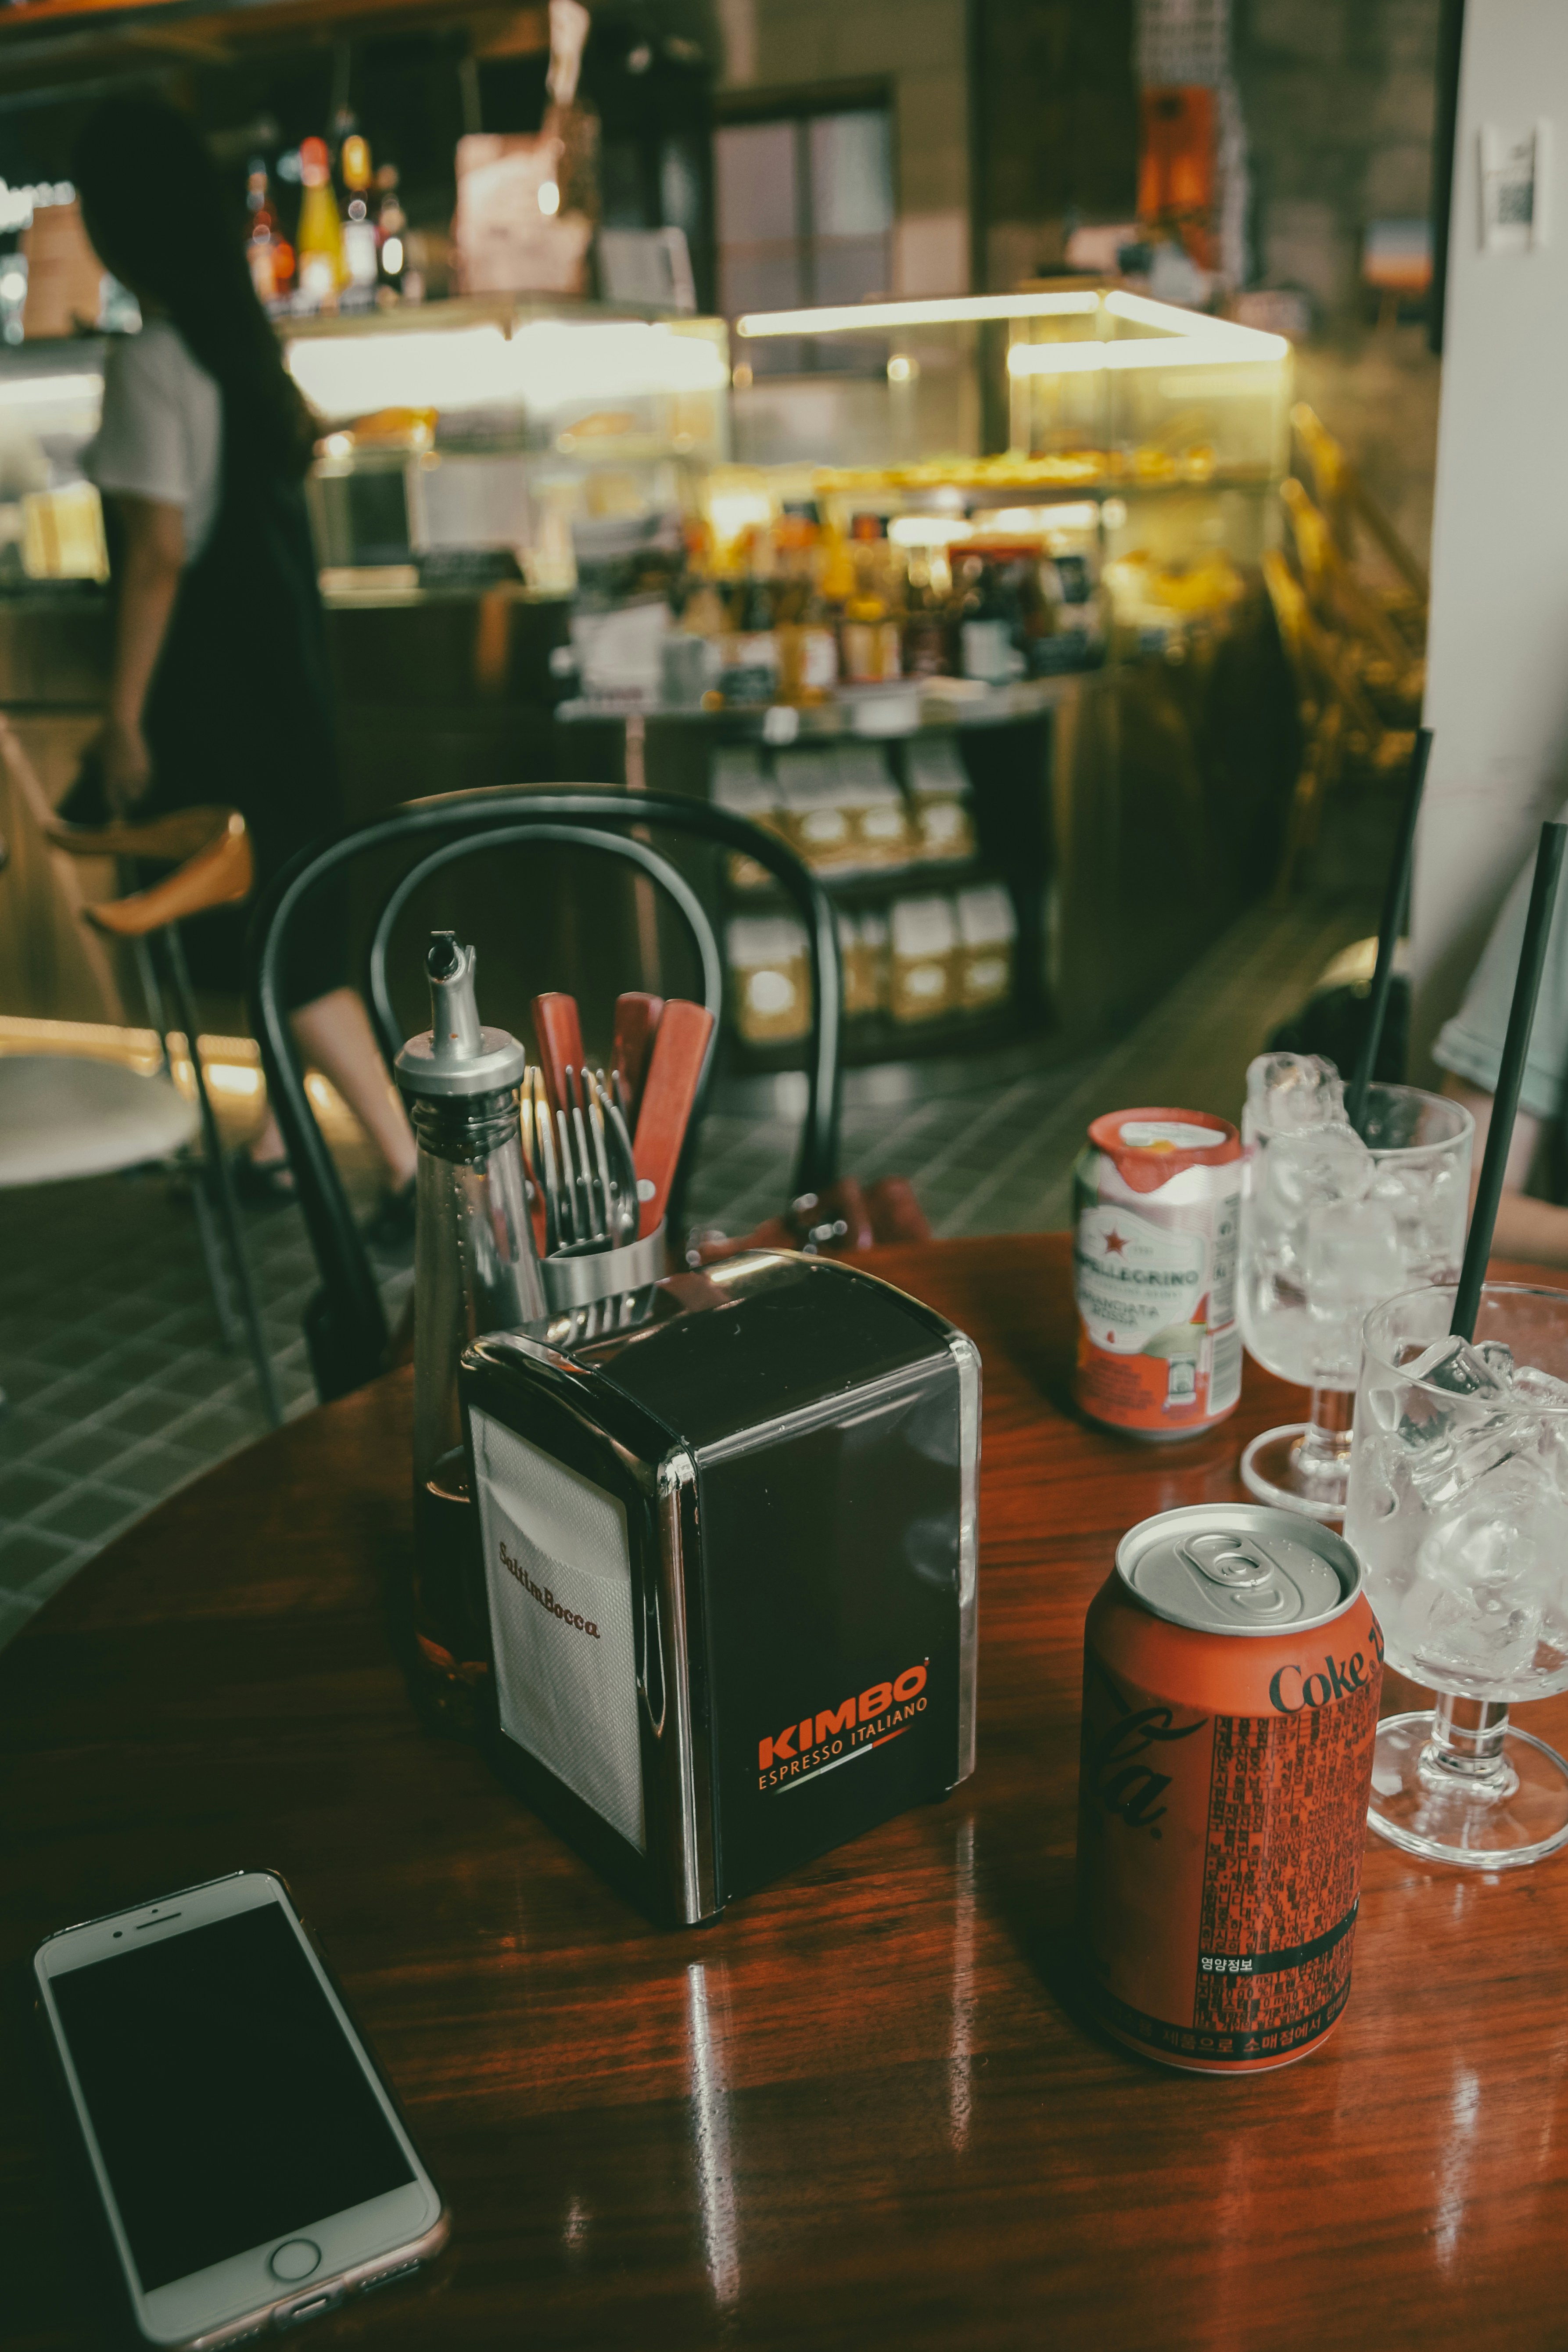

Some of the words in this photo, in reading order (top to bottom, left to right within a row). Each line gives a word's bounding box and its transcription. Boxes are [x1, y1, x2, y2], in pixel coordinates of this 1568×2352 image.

[499, 1541, 600, 1638] SaltimBocca
[759, 1666, 927, 1770] KIMBO
[1269, 1651, 1368, 1713] Coke
[759, 1740, 843, 1790] ESPRESSO
[851, 1697, 927, 1745] ITALIANO
[1201, 1957, 1252, 1972] 영양정보
[1163, 2029, 1234, 2053] 제품으로
[1244, 2014, 1320, 2052] 소매점에서
